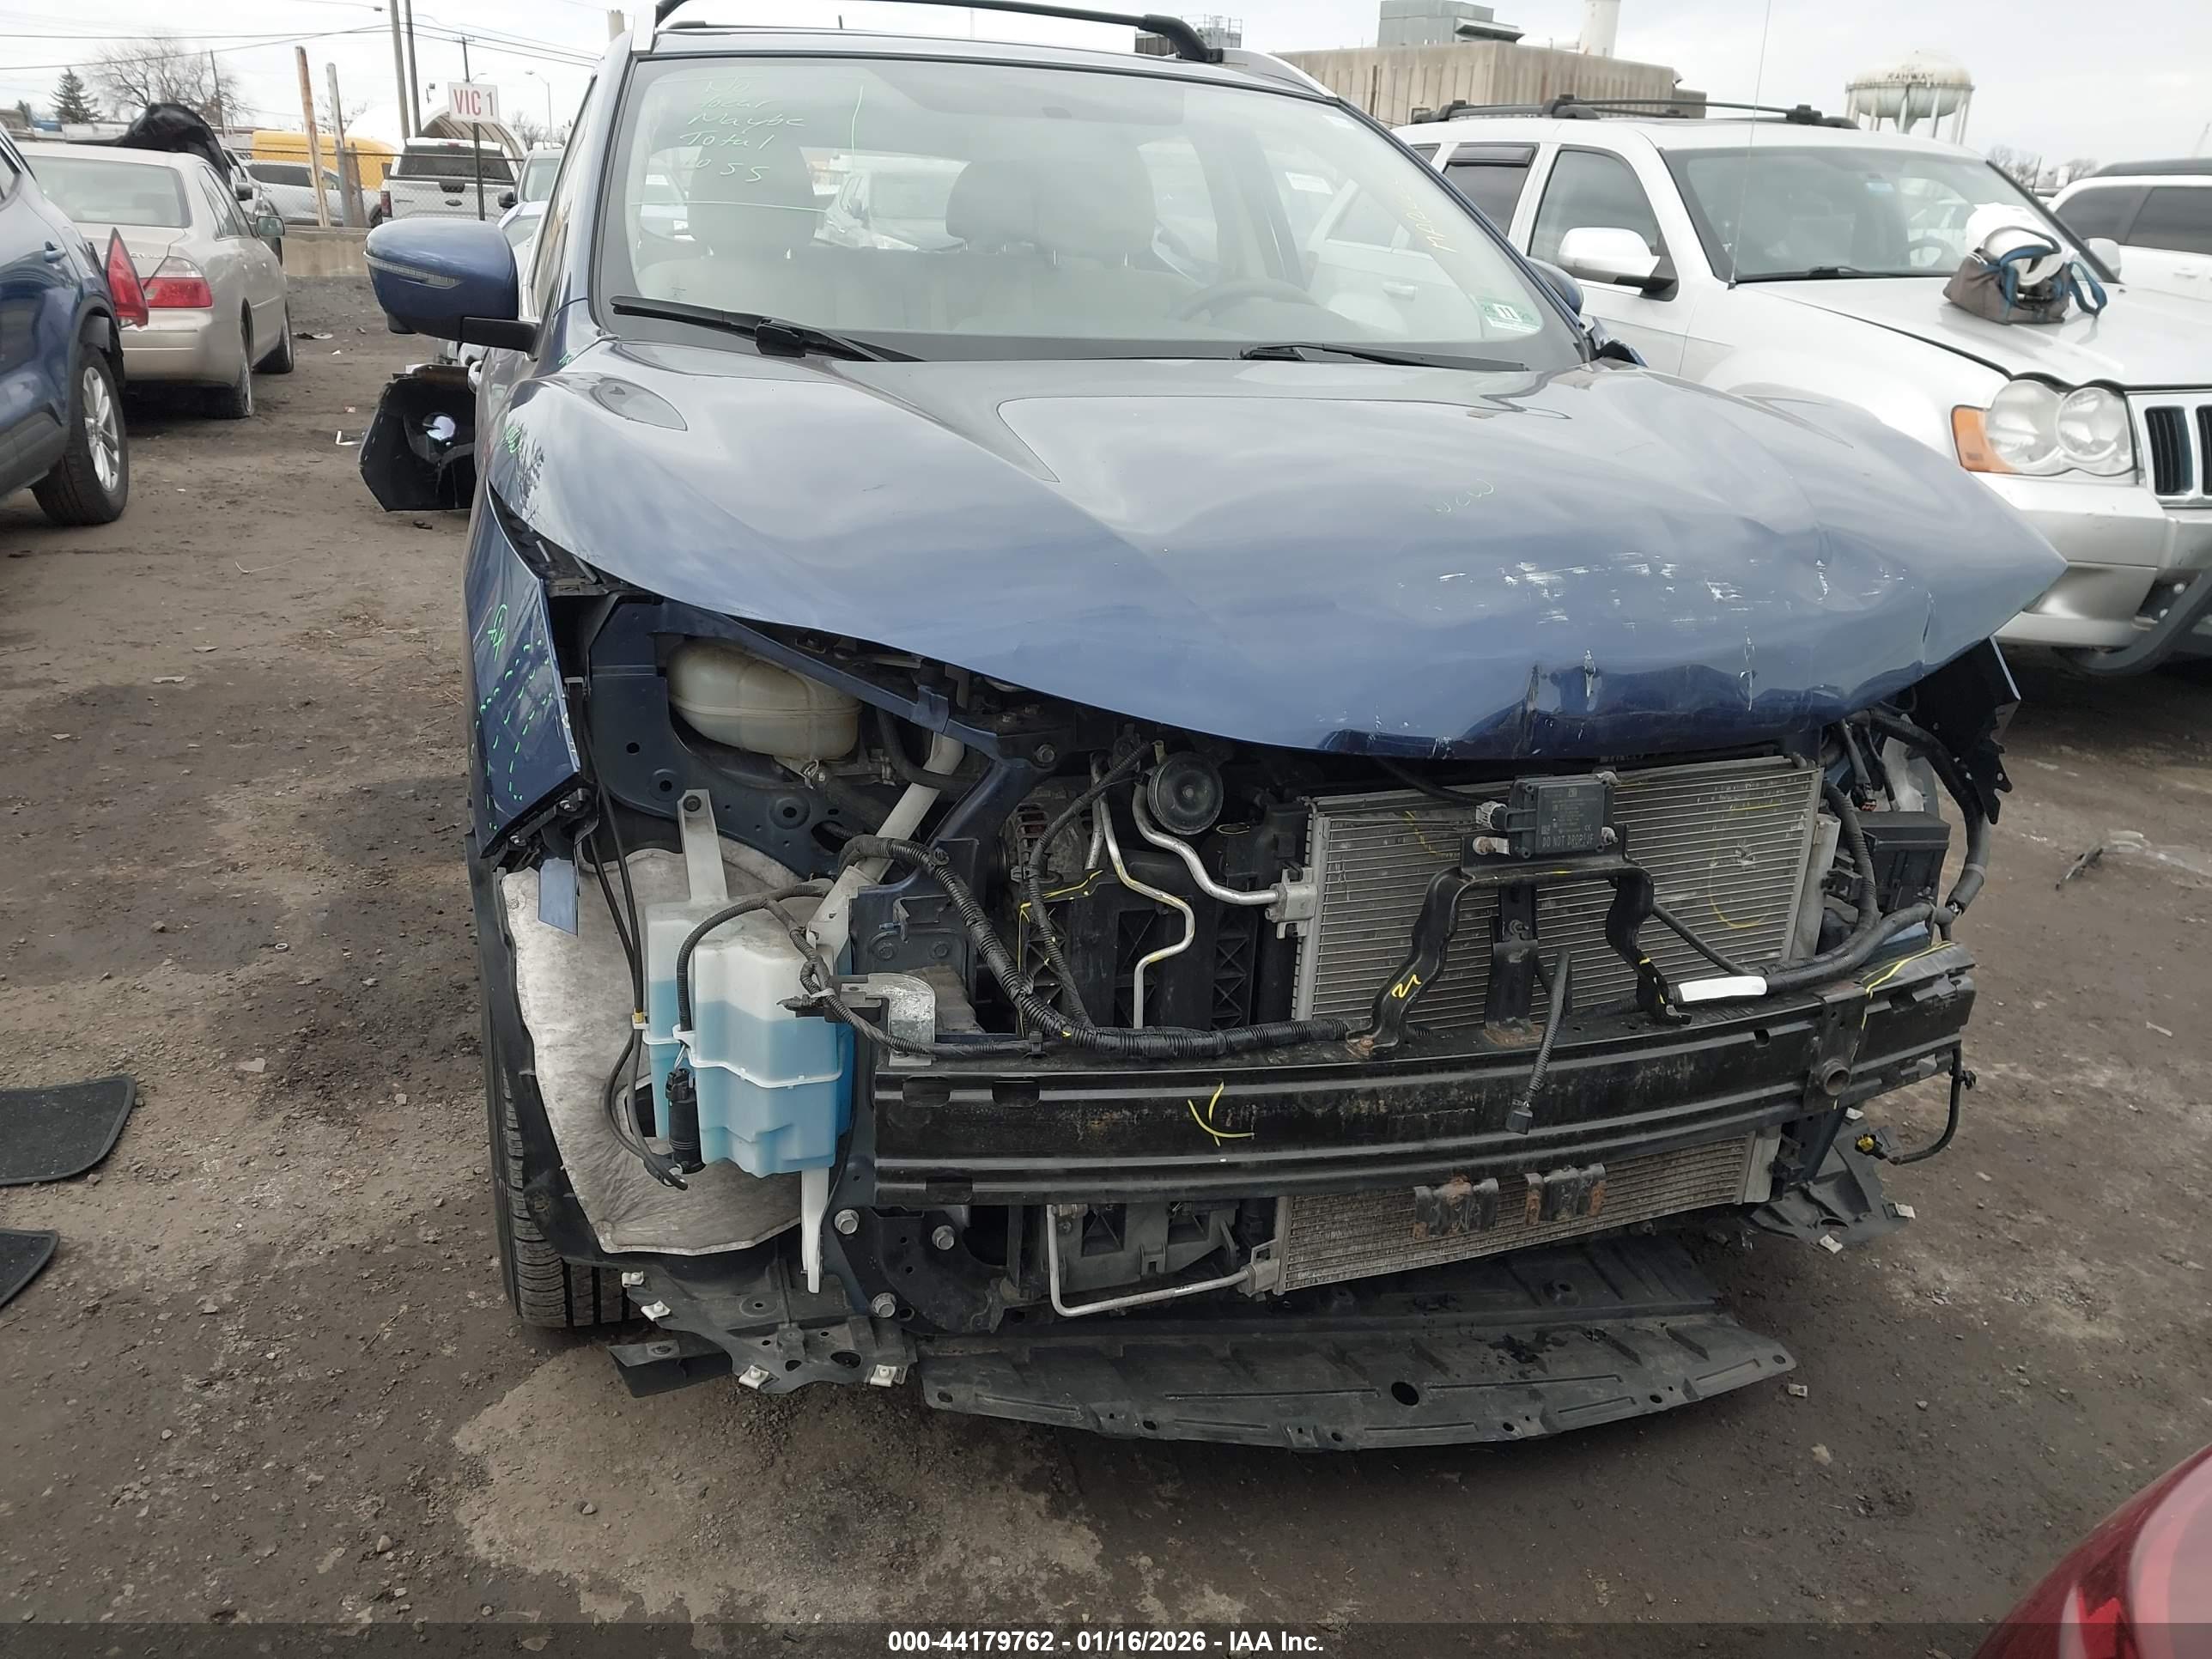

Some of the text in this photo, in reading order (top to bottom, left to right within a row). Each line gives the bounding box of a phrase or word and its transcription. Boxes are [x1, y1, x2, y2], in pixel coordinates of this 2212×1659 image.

[1887, 72, 1935, 82] RAHWAY
[453, 89, 494, 116] VIC 1
[680, 130, 775, 150] Total
[1542, 836, 1551, 848] DO
[1553, 835, 1565, 847] NOT
